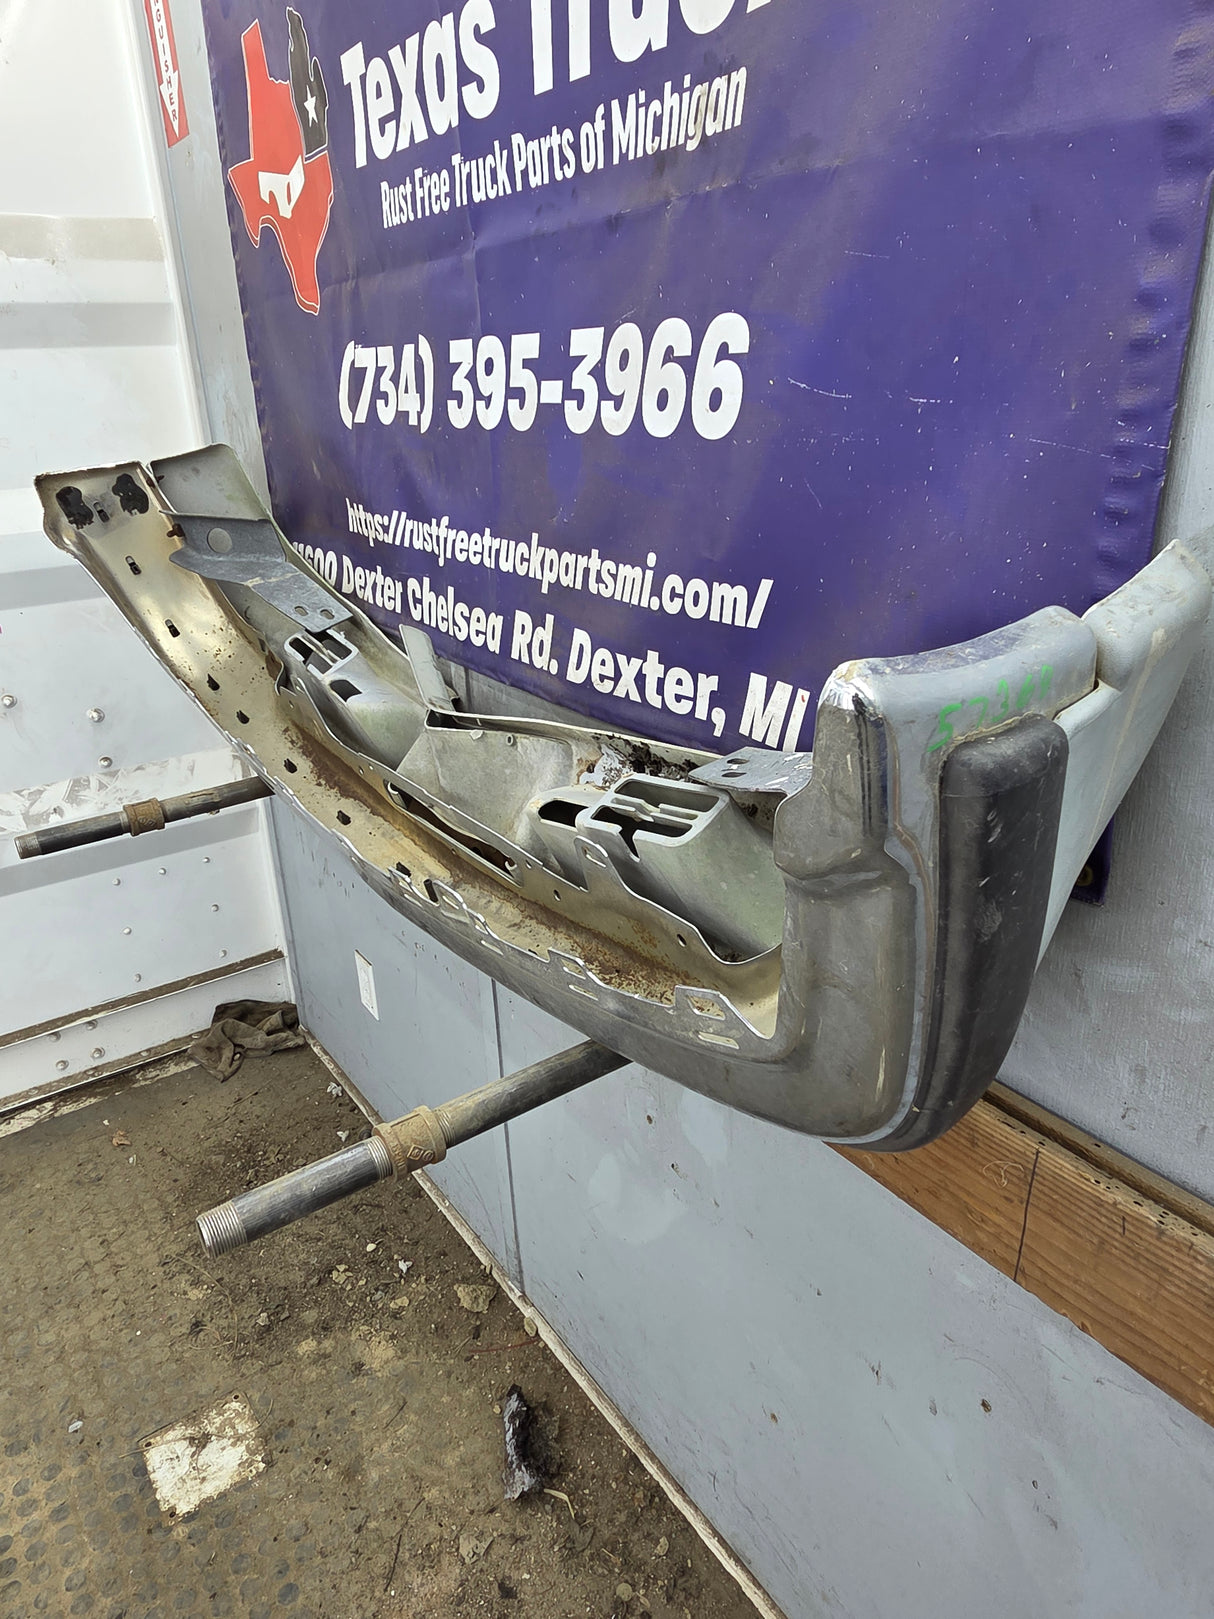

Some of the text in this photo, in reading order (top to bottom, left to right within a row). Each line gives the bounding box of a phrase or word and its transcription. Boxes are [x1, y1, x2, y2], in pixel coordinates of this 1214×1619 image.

[340, 0, 500, 169] Texas
[380, 66, 747, 229] Rust Free Truck Parts of Michigan
[338, 312, 750, 440] (734) 395-3966
[346, 497, 774, 629] https://rustfreetruckpartsmi.com/
[341, 554, 403, 613] Dexter
[407, 575, 504, 655] Chelsea
[511, 609, 559, 675] Rd.
[566, 628, 726, 738] Dexter,
[738, 672, 811, 753] MI
